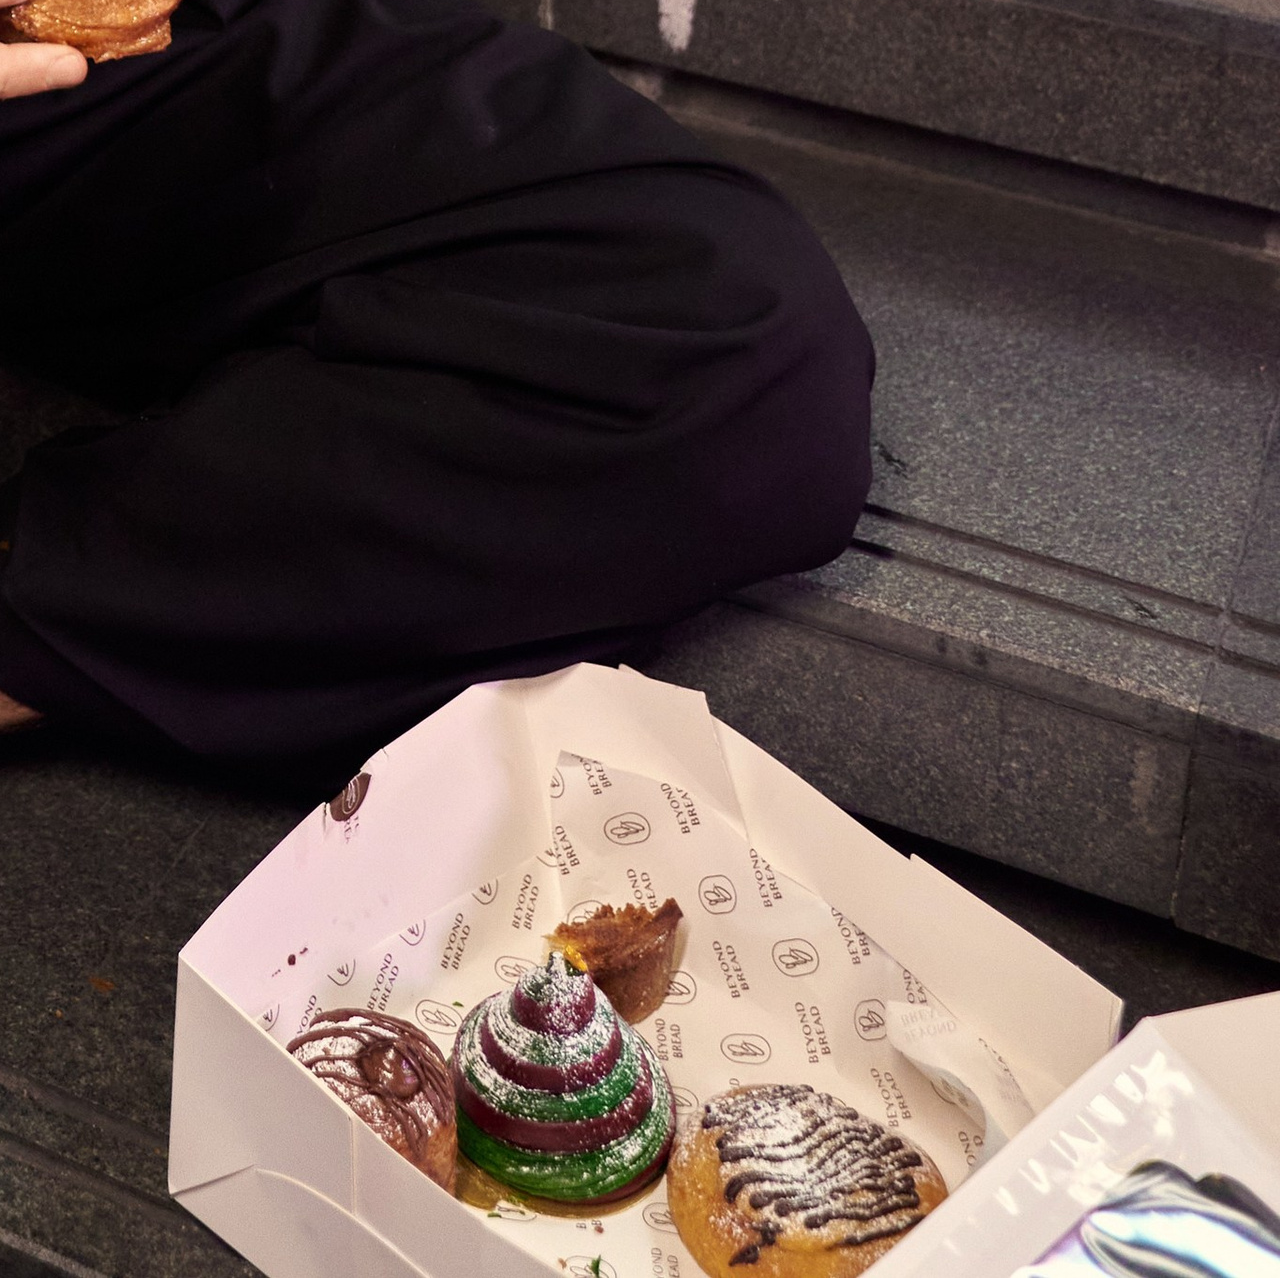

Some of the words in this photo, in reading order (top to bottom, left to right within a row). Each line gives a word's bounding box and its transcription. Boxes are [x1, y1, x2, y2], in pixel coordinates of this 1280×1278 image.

[571, 754, 602, 795] BEYO
[593, 760, 612, 788] BRE
[660, 783, 691, 834] BEYOND
[555, 825, 580, 867] BREAD
[641, 872, 658, 909] READ
[750, 848, 773, 908] BEYOND
[761, 857, 782, 899] BREA
[512, 874, 532, 929] BEYOND
[523, 886, 539, 930] BREAD
[440, 913, 464, 969] BEYOND
[451, 925, 471, 970] BREAD
[852, 923, 871, 956] BRE
[367, 953, 392, 1011] BEYOND
[377, 965, 399, 1012] BREAD
[712, 941, 741, 998] BEYOND
[726, 945, 750, 990] BREAD
[655, 1018, 669, 1061] BEYOND
[670, 1024, 683, 1058] BREAD
[795, 1002, 819, 1063] BEYOND
[810, 1006, 831, 1055] BREAD
[871, 1068, 899, 1127] BEYOND
[884, 1072, 912, 1119] BREAD
